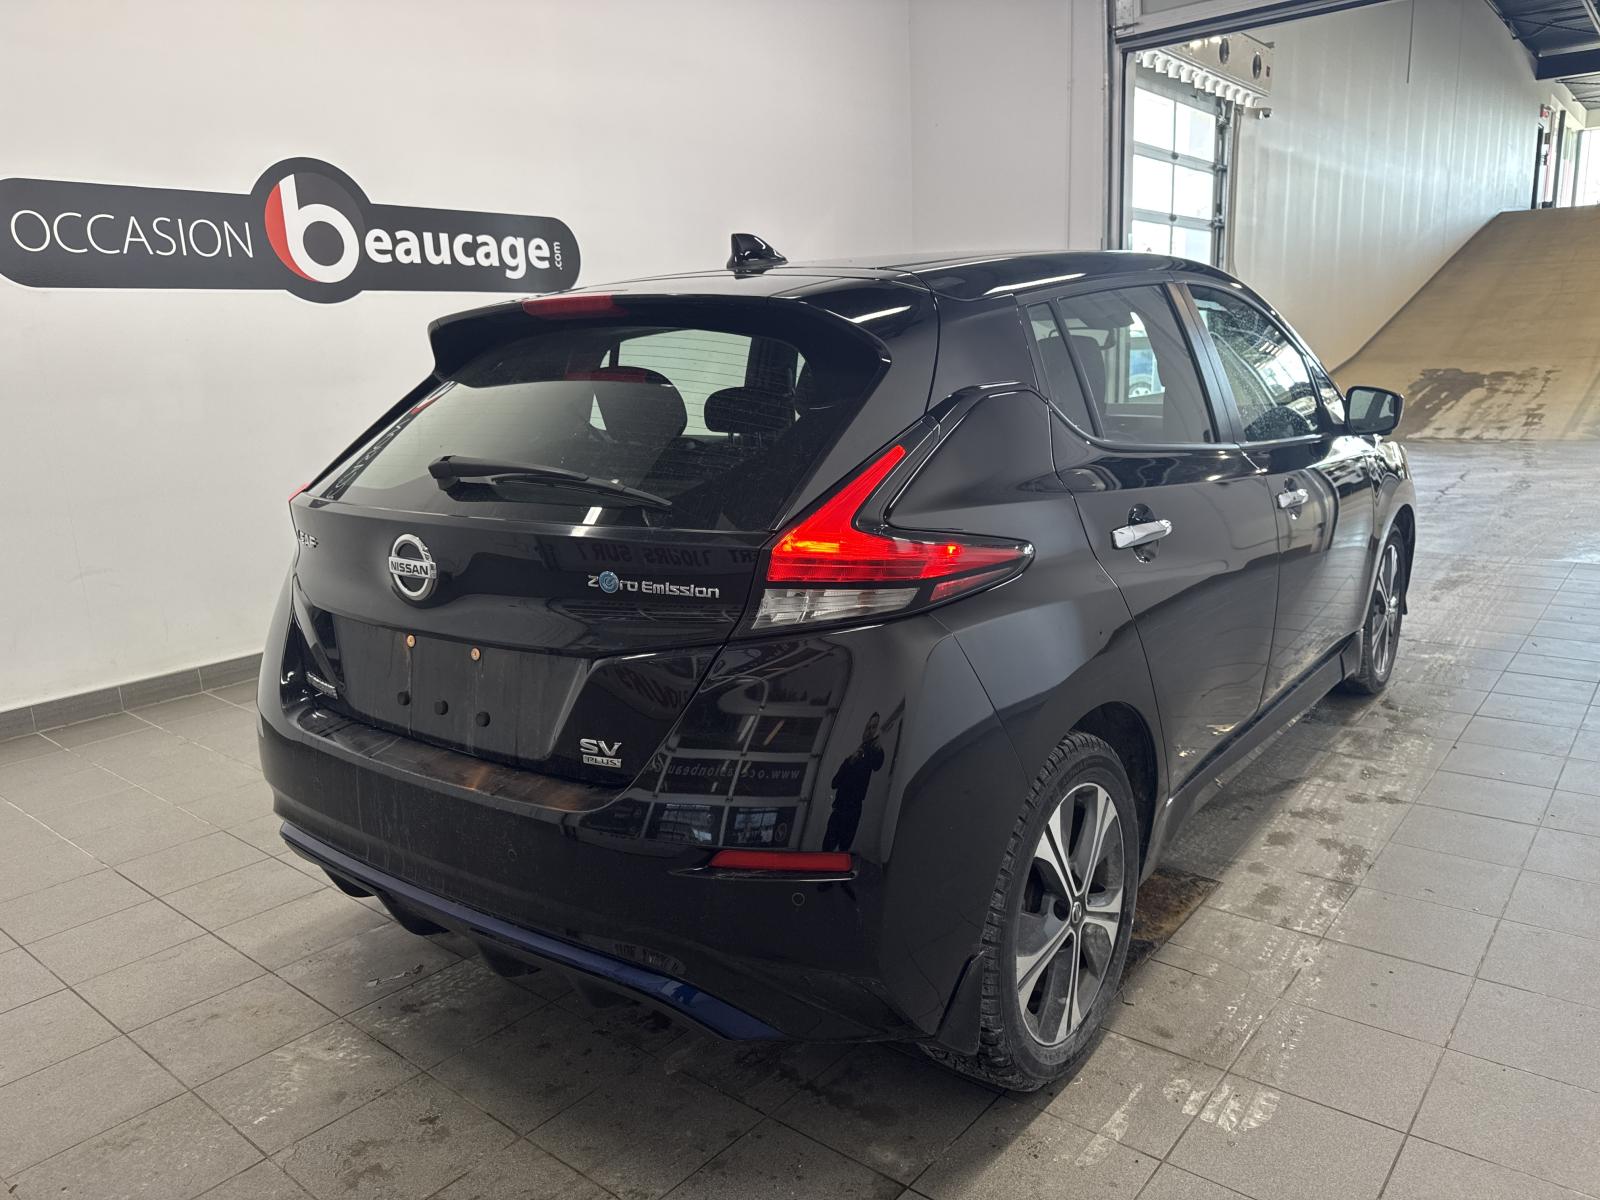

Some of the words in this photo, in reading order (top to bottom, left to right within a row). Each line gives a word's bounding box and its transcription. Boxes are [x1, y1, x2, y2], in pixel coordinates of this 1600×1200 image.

[11, 210, 253, 257] OCCASION
[390, 560, 429, 576] NISSAN
[641, 580, 720, 599] Emission
[579, 738, 622, 757] SV
[586, 756, 617, 767] PLUS
